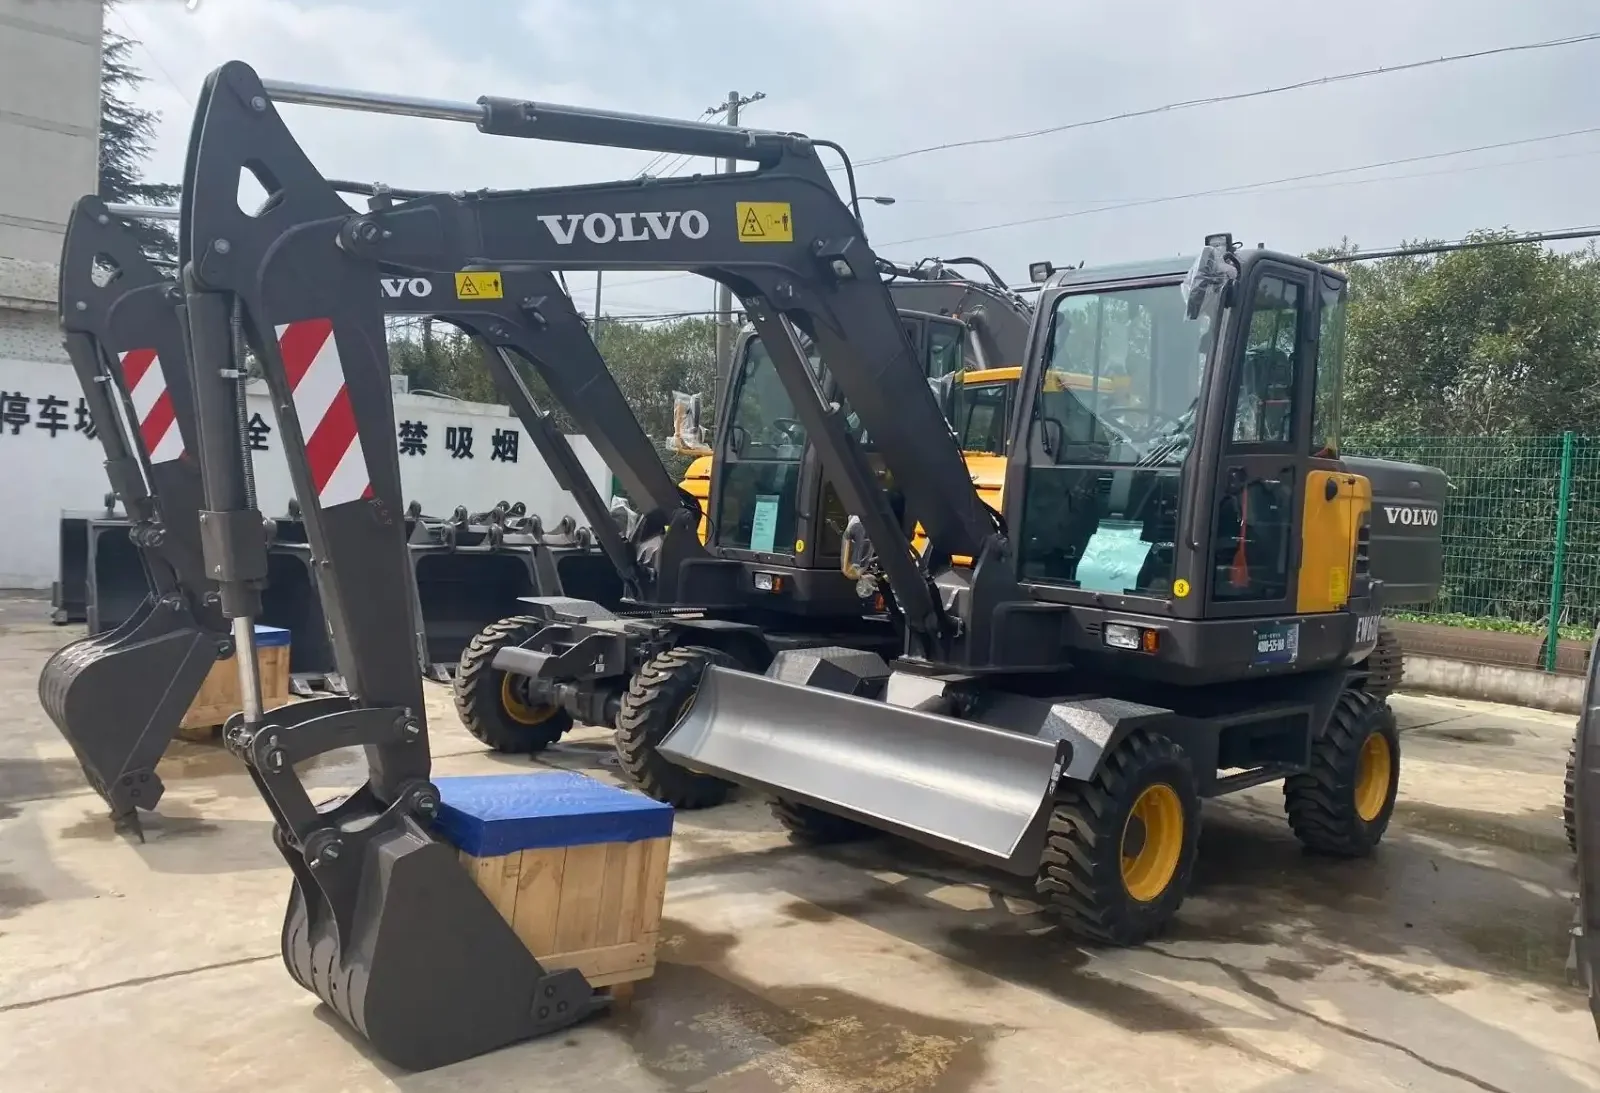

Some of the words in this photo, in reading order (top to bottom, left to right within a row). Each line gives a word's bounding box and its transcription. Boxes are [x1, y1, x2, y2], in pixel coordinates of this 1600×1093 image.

[537, 209, 709, 244] VOLVO
[381, 277, 432, 298] VO
[1384, 507, 1438, 526] VOLVO
[1178, 582, 1185, 595] 3
